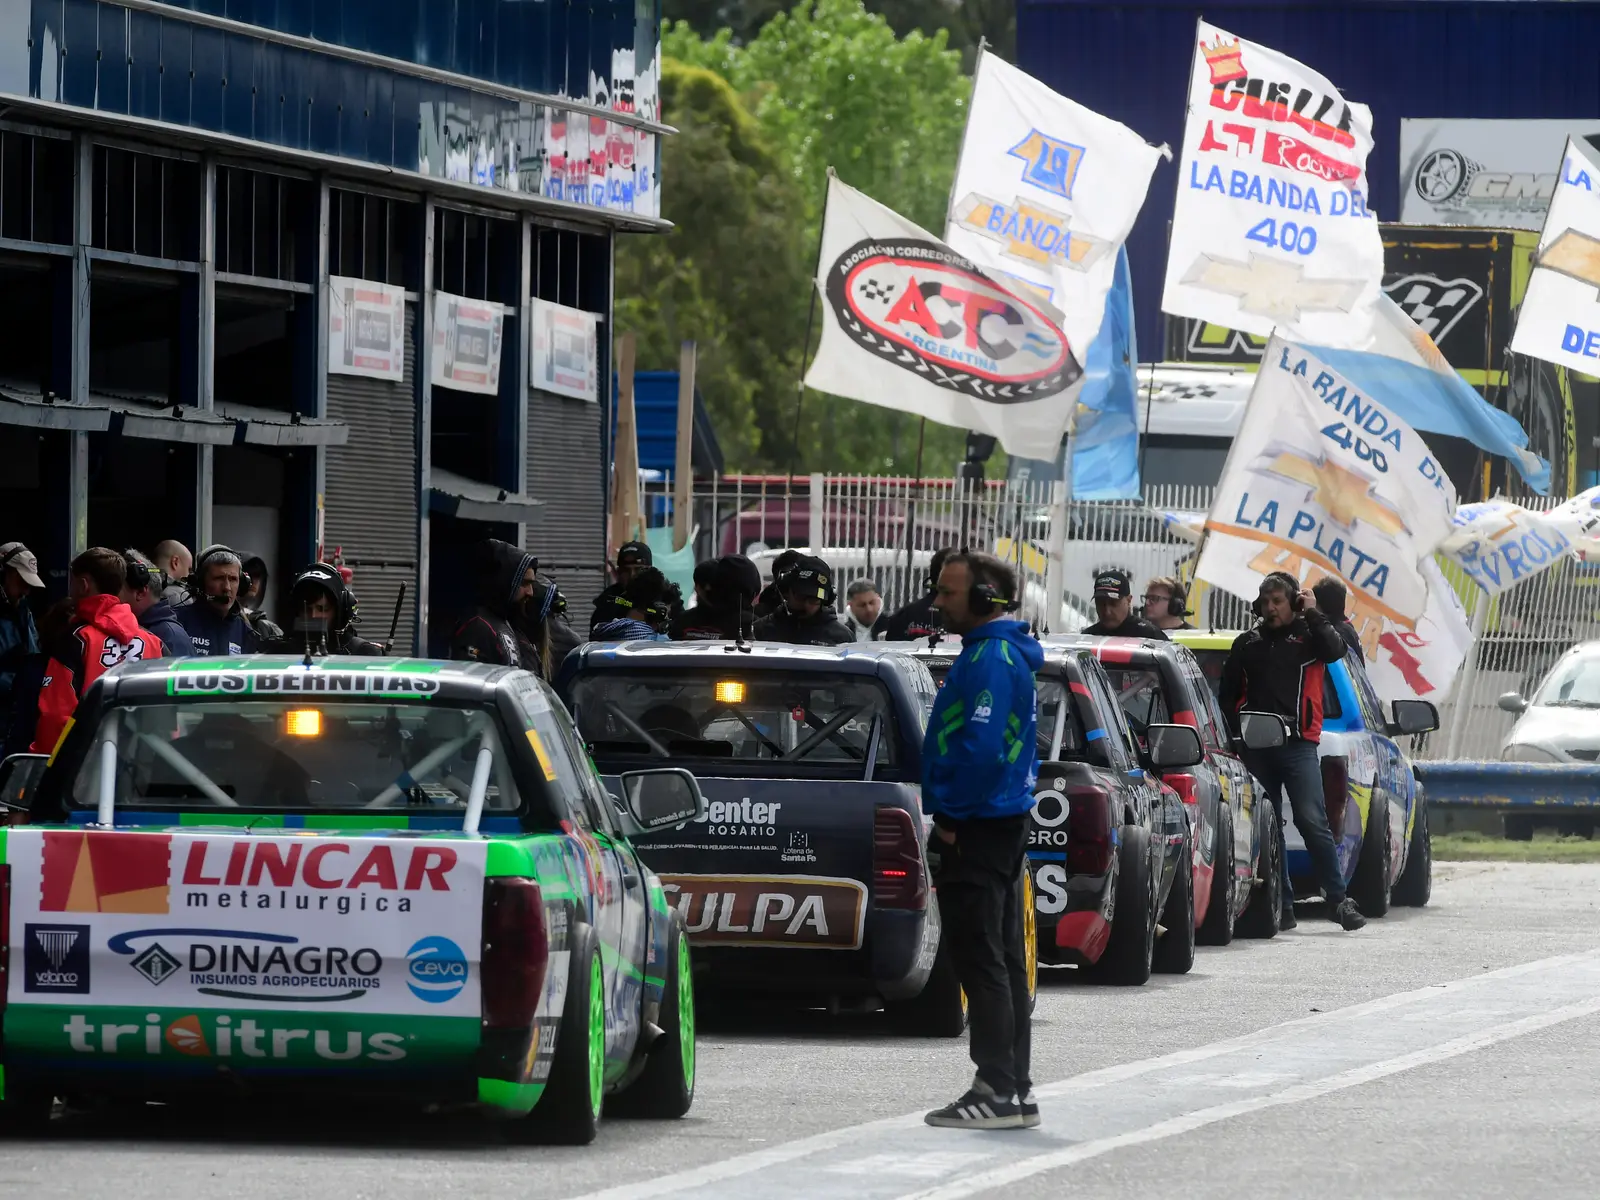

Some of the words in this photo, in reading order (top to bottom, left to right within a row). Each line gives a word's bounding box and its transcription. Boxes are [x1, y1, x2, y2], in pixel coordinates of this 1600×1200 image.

[1190, 160, 1225, 194] LA
[1230, 170, 1321, 216] BANDA
[1329, 189, 1373, 218] DEL
[986, 204, 1071, 260] BANDA
[1245, 218, 1317, 255] 400
[884, 275, 1024, 361] ACTC
[904, 331, 999, 372] ARGENTINA
[1279, 347, 1307, 377] LA
[1320, 422, 1389, 473] 400
[1234, 492, 1280, 533] LA
[1288, 510, 1390, 598] PLATA
[99, 636, 145, 668] 32
[191, 636, 210, 646] RUS
[175, 673, 246, 691] LOS
[254, 674, 440, 693] BERNITAS
[708, 825, 776, 837] ROSARIO
[182, 840, 458, 891] LINCAR
[781, 854, 806, 862] Santa
[186, 890, 412, 915] metalurgica
[189, 943, 382, 977] DINAGRO
[190, 974, 259, 986] INSUMOS
[262, 975, 381, 989] AGROPECUARIOS
